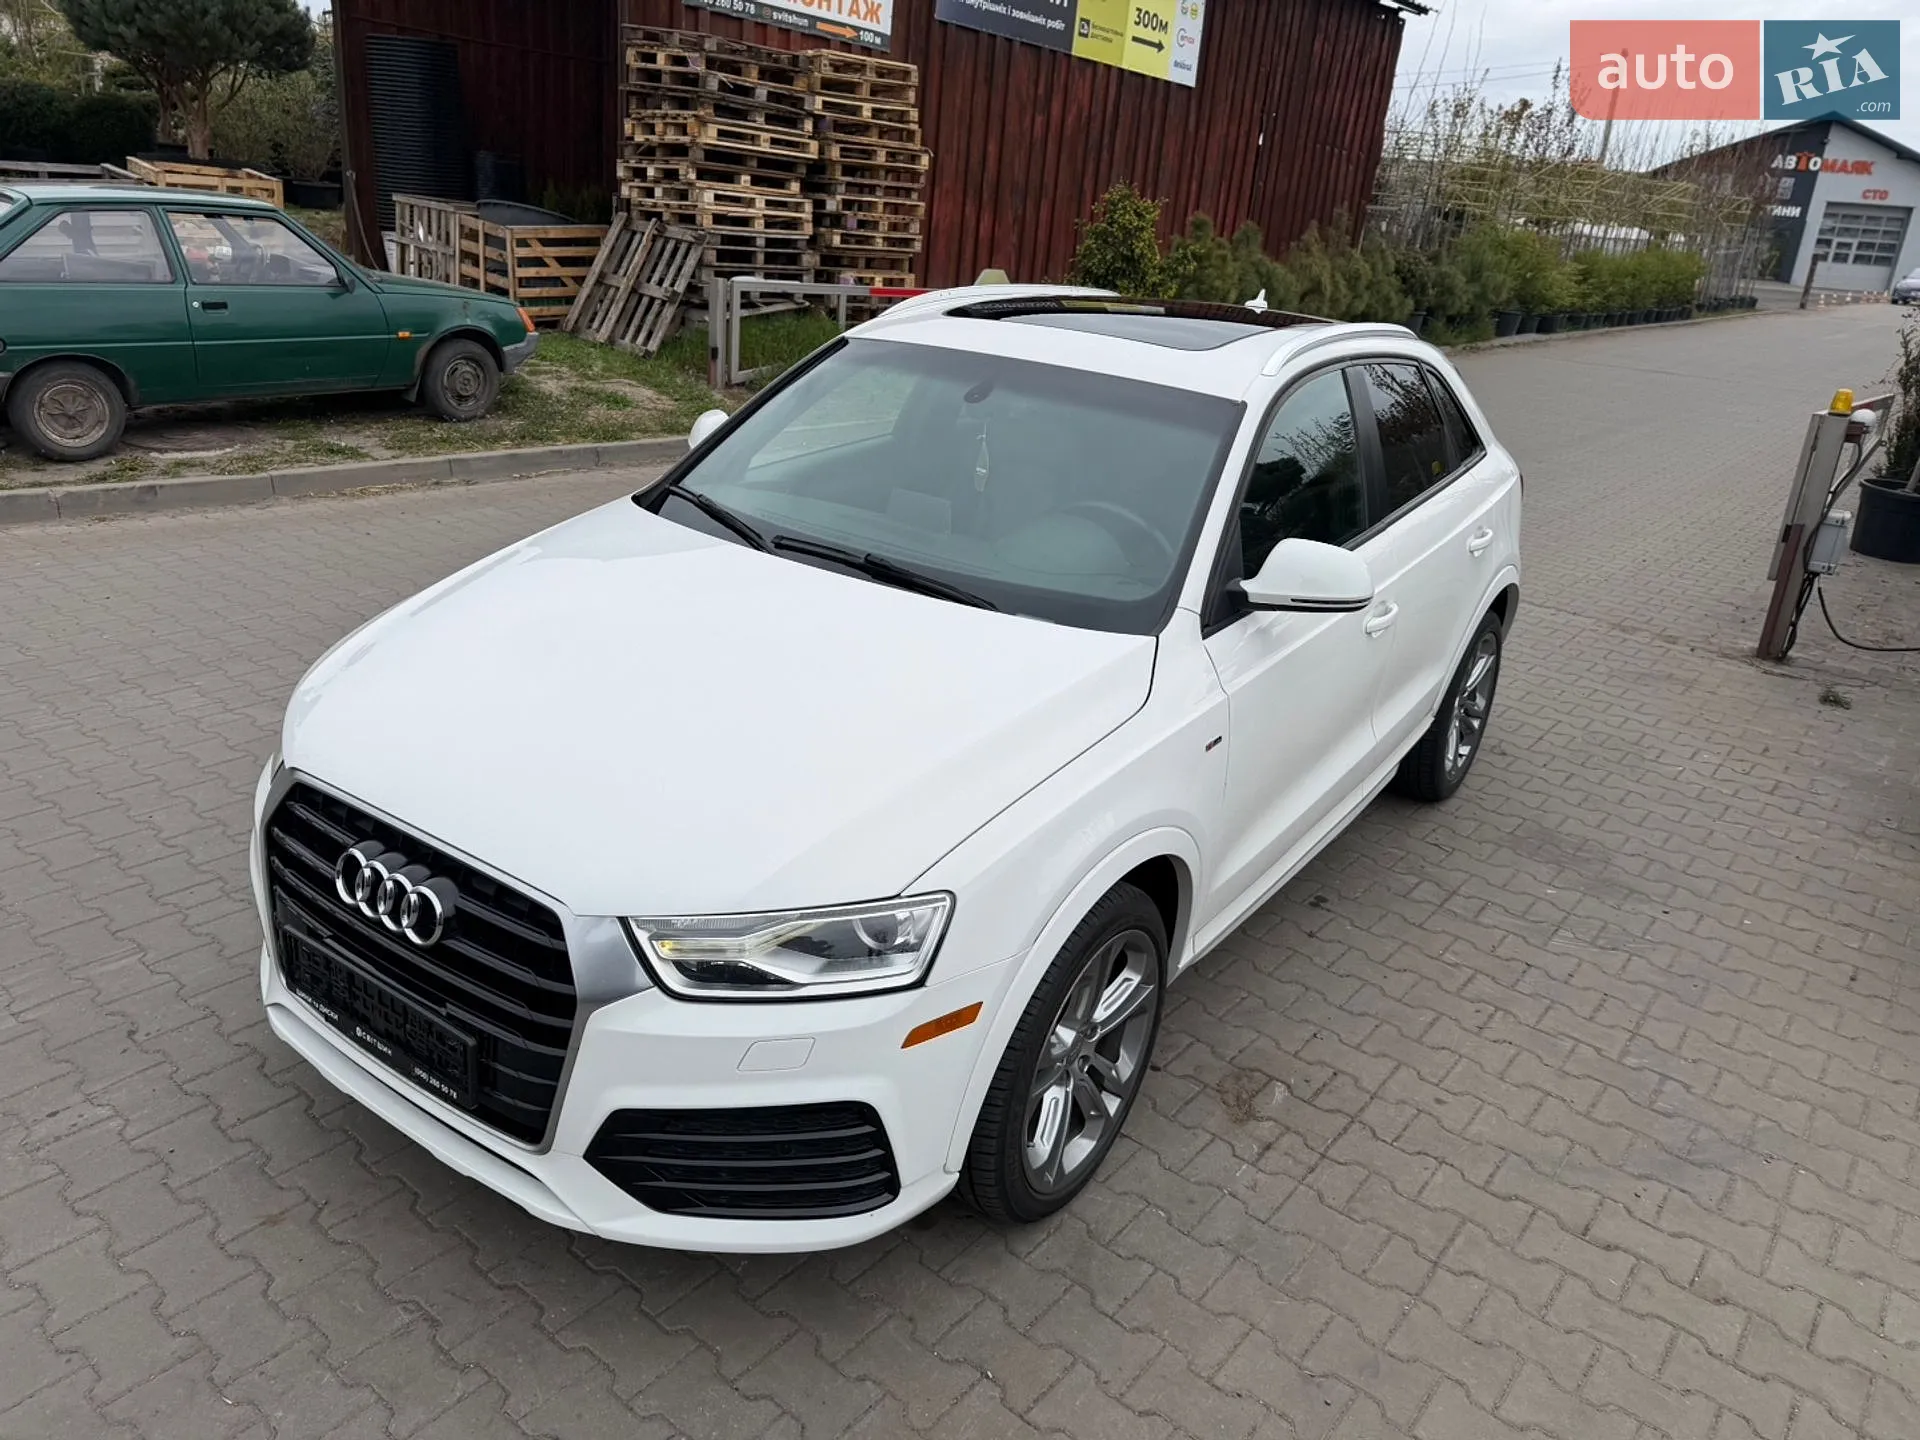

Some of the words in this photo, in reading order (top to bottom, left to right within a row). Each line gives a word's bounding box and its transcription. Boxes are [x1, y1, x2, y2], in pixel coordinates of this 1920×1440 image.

[732, 0, 744, 11] 50
[786, 0, 882, 25] НТАЖ
[859, 30, 874, 43] 100
[1770, 153, 1874, 176] АВТОМАЯК
[1862, 189, 1889, 200] СТО
